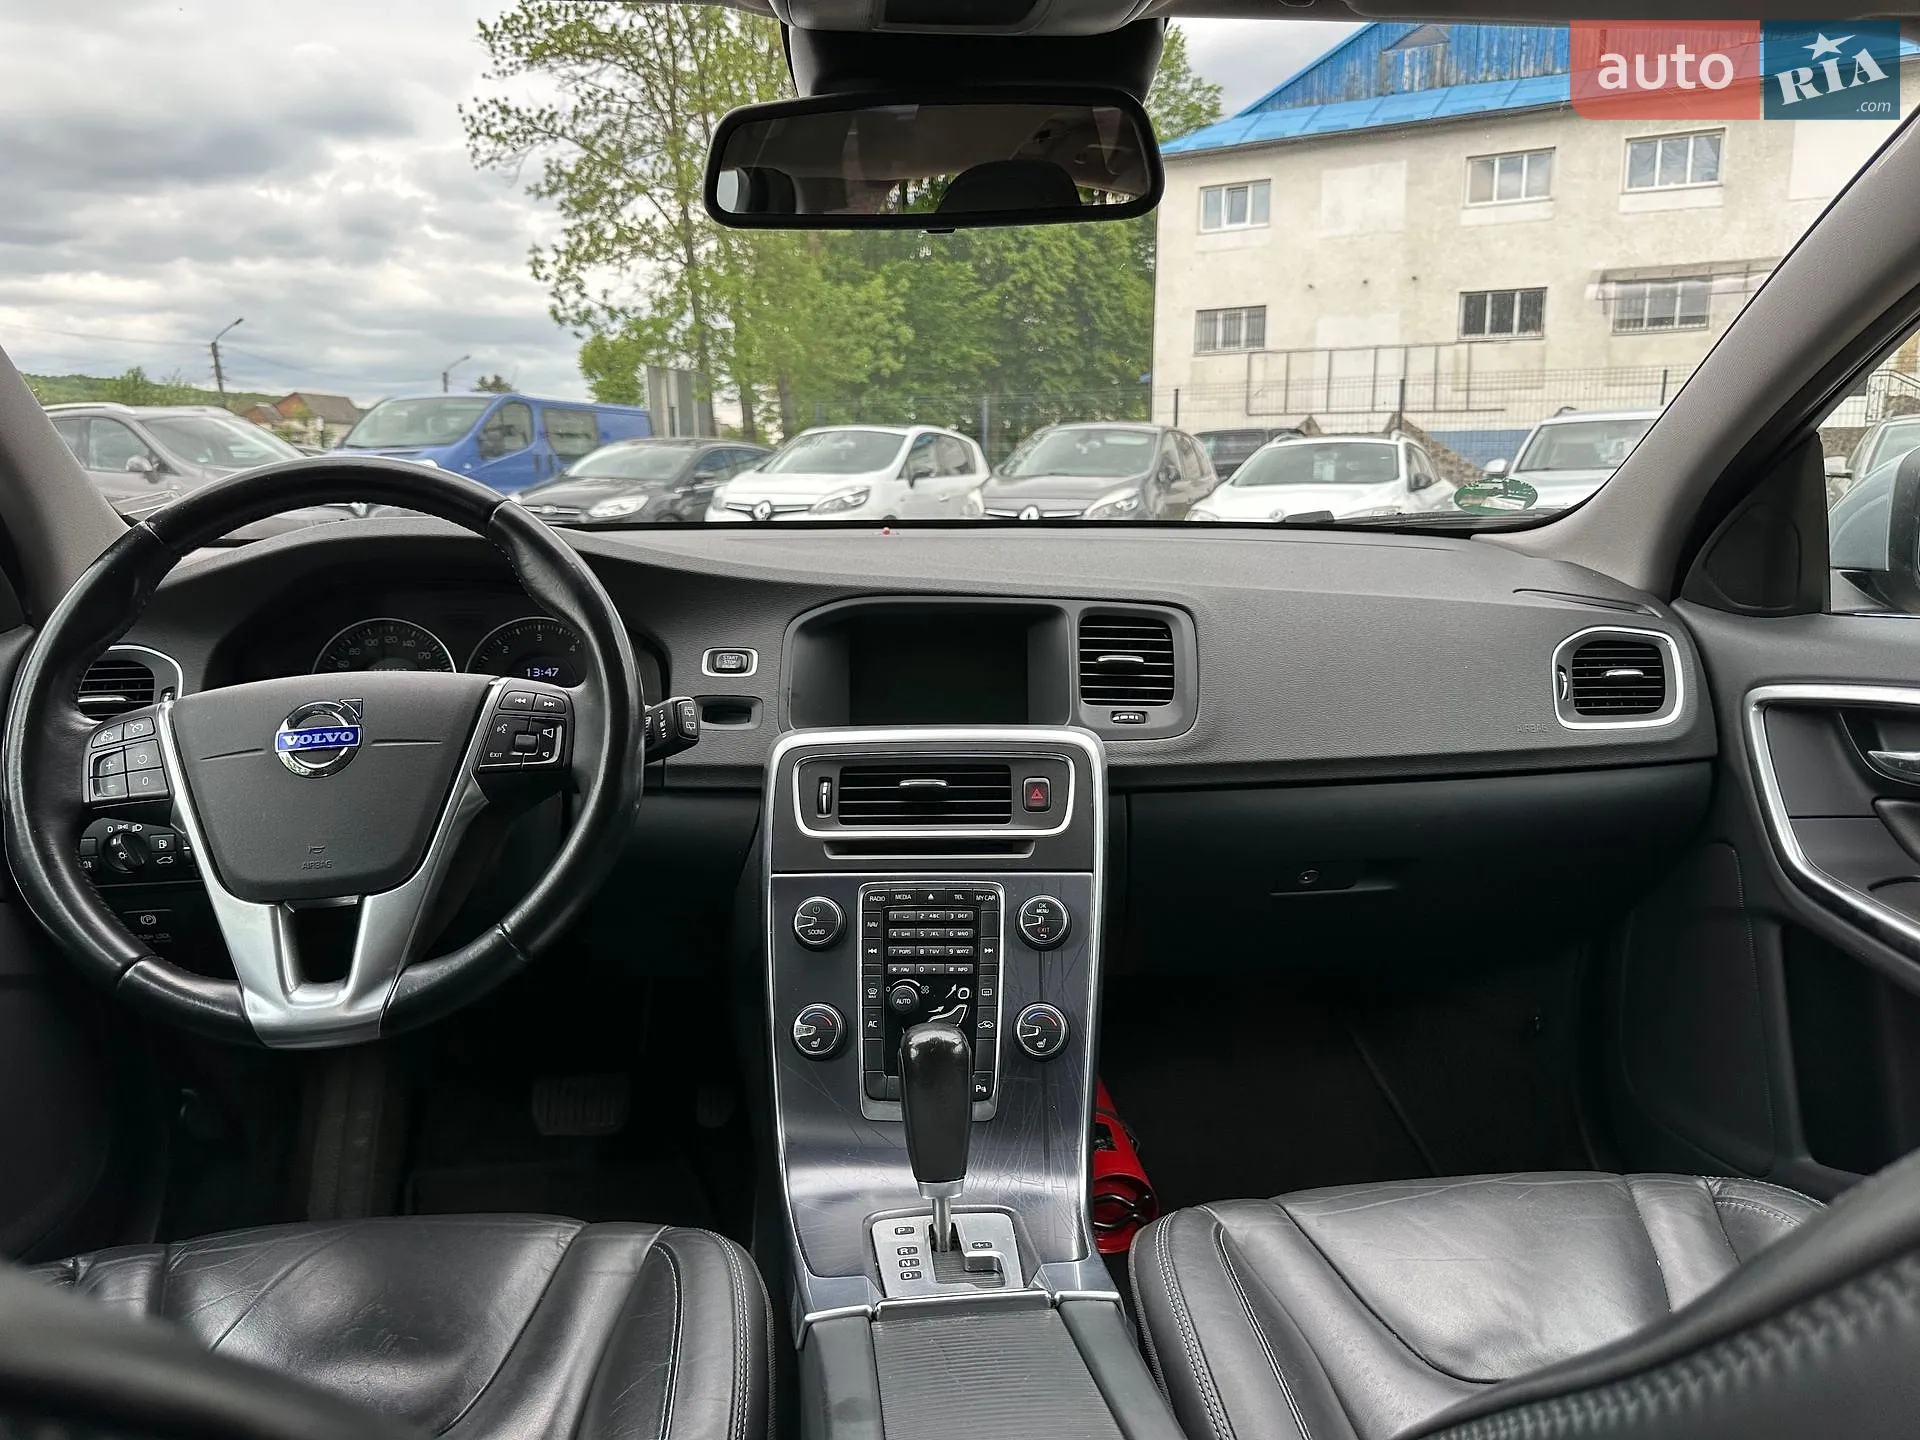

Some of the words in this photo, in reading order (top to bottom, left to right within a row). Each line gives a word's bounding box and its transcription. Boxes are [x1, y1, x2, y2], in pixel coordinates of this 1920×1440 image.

[526, 667, 560, 677] 13:47
[282, 731, 355, 746] VOLVO
[868, 1020, 878, 1028] AC
